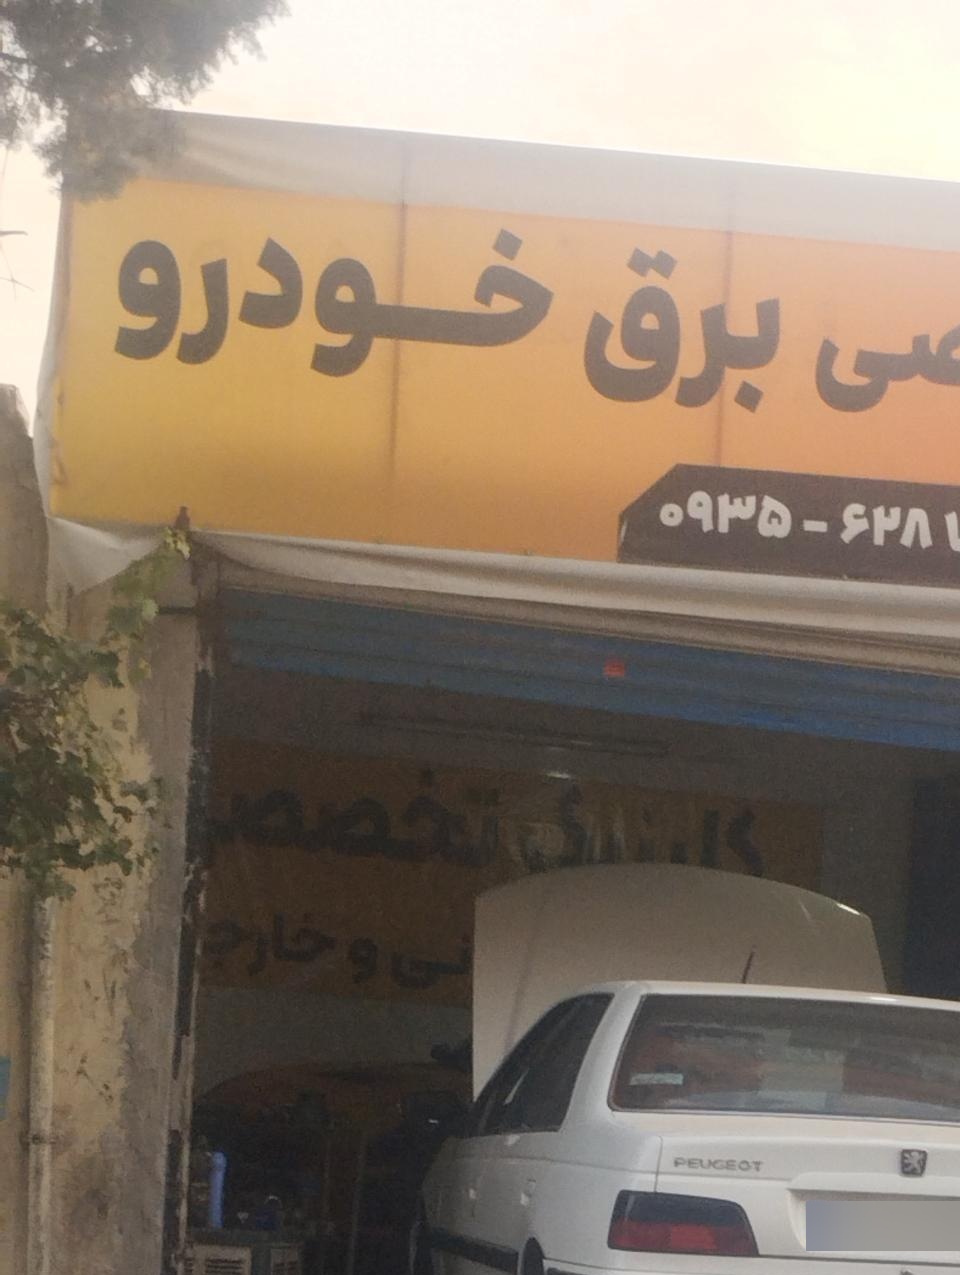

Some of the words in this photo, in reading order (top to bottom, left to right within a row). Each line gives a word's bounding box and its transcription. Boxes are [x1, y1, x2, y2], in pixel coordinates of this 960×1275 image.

[114, 228, 555, 377] خودرو
[583, 247, 782, 414] برق
[673, 1156, 763, 1172] PEUGEOT
